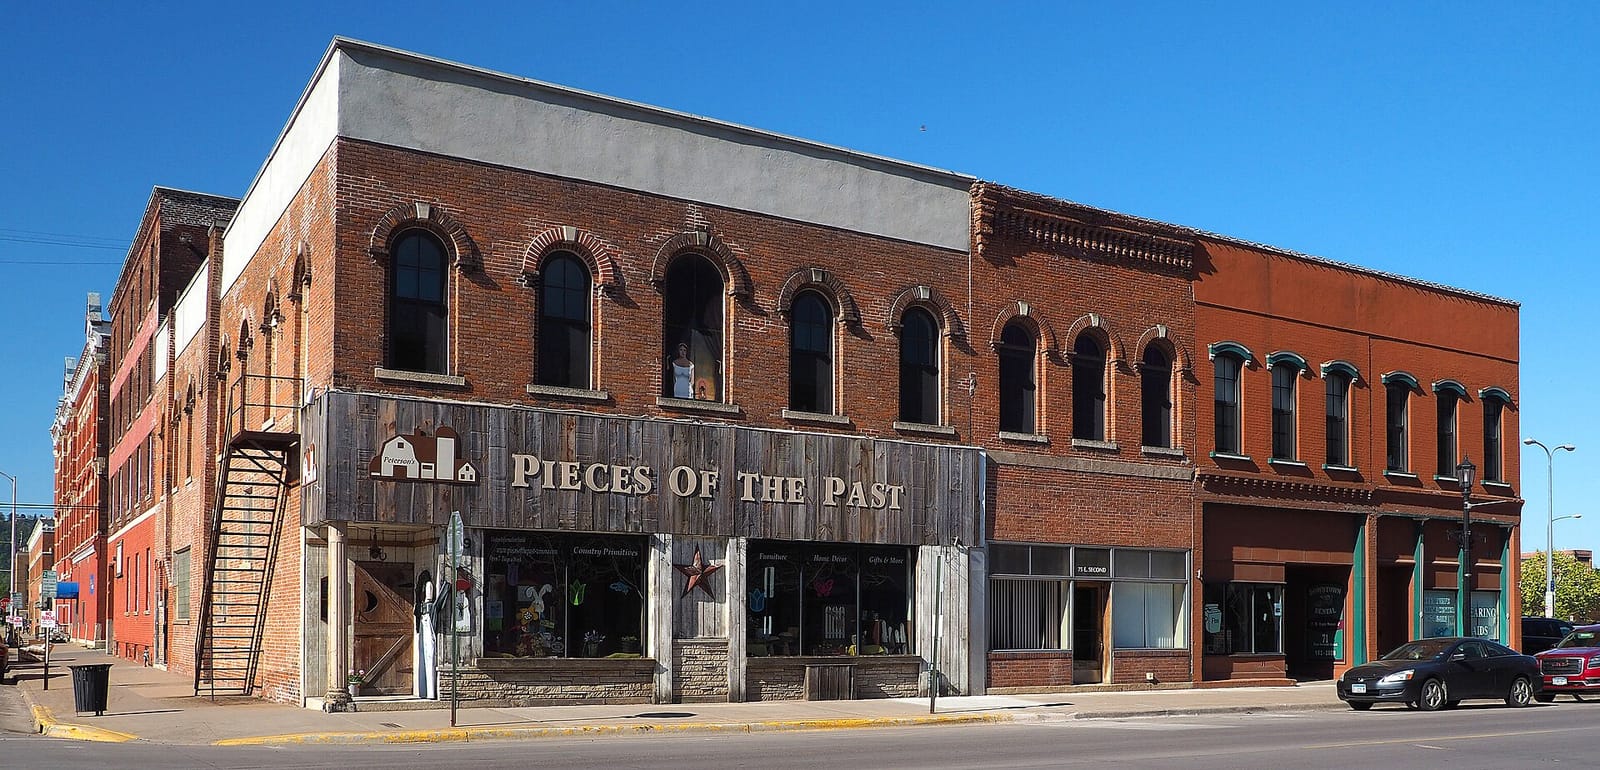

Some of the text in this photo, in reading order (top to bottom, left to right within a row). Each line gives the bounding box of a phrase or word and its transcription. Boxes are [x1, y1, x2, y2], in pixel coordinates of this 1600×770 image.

[383, 456, 416, 465] Peterson's
[511, 453, 904, 510] PIECES OF THE PAST
[573, 546, 639, 558] Country Primitives
[759, 552, 789, 561] Furniture
[813, 554, 830, 562] Home
[868, 556, 883, 565] Gifts
[1314, 607, 1337, 615] DENTAL
[1471, 625, 1489, 636] AIDS
[1321, 633, 1329, 644] 71
